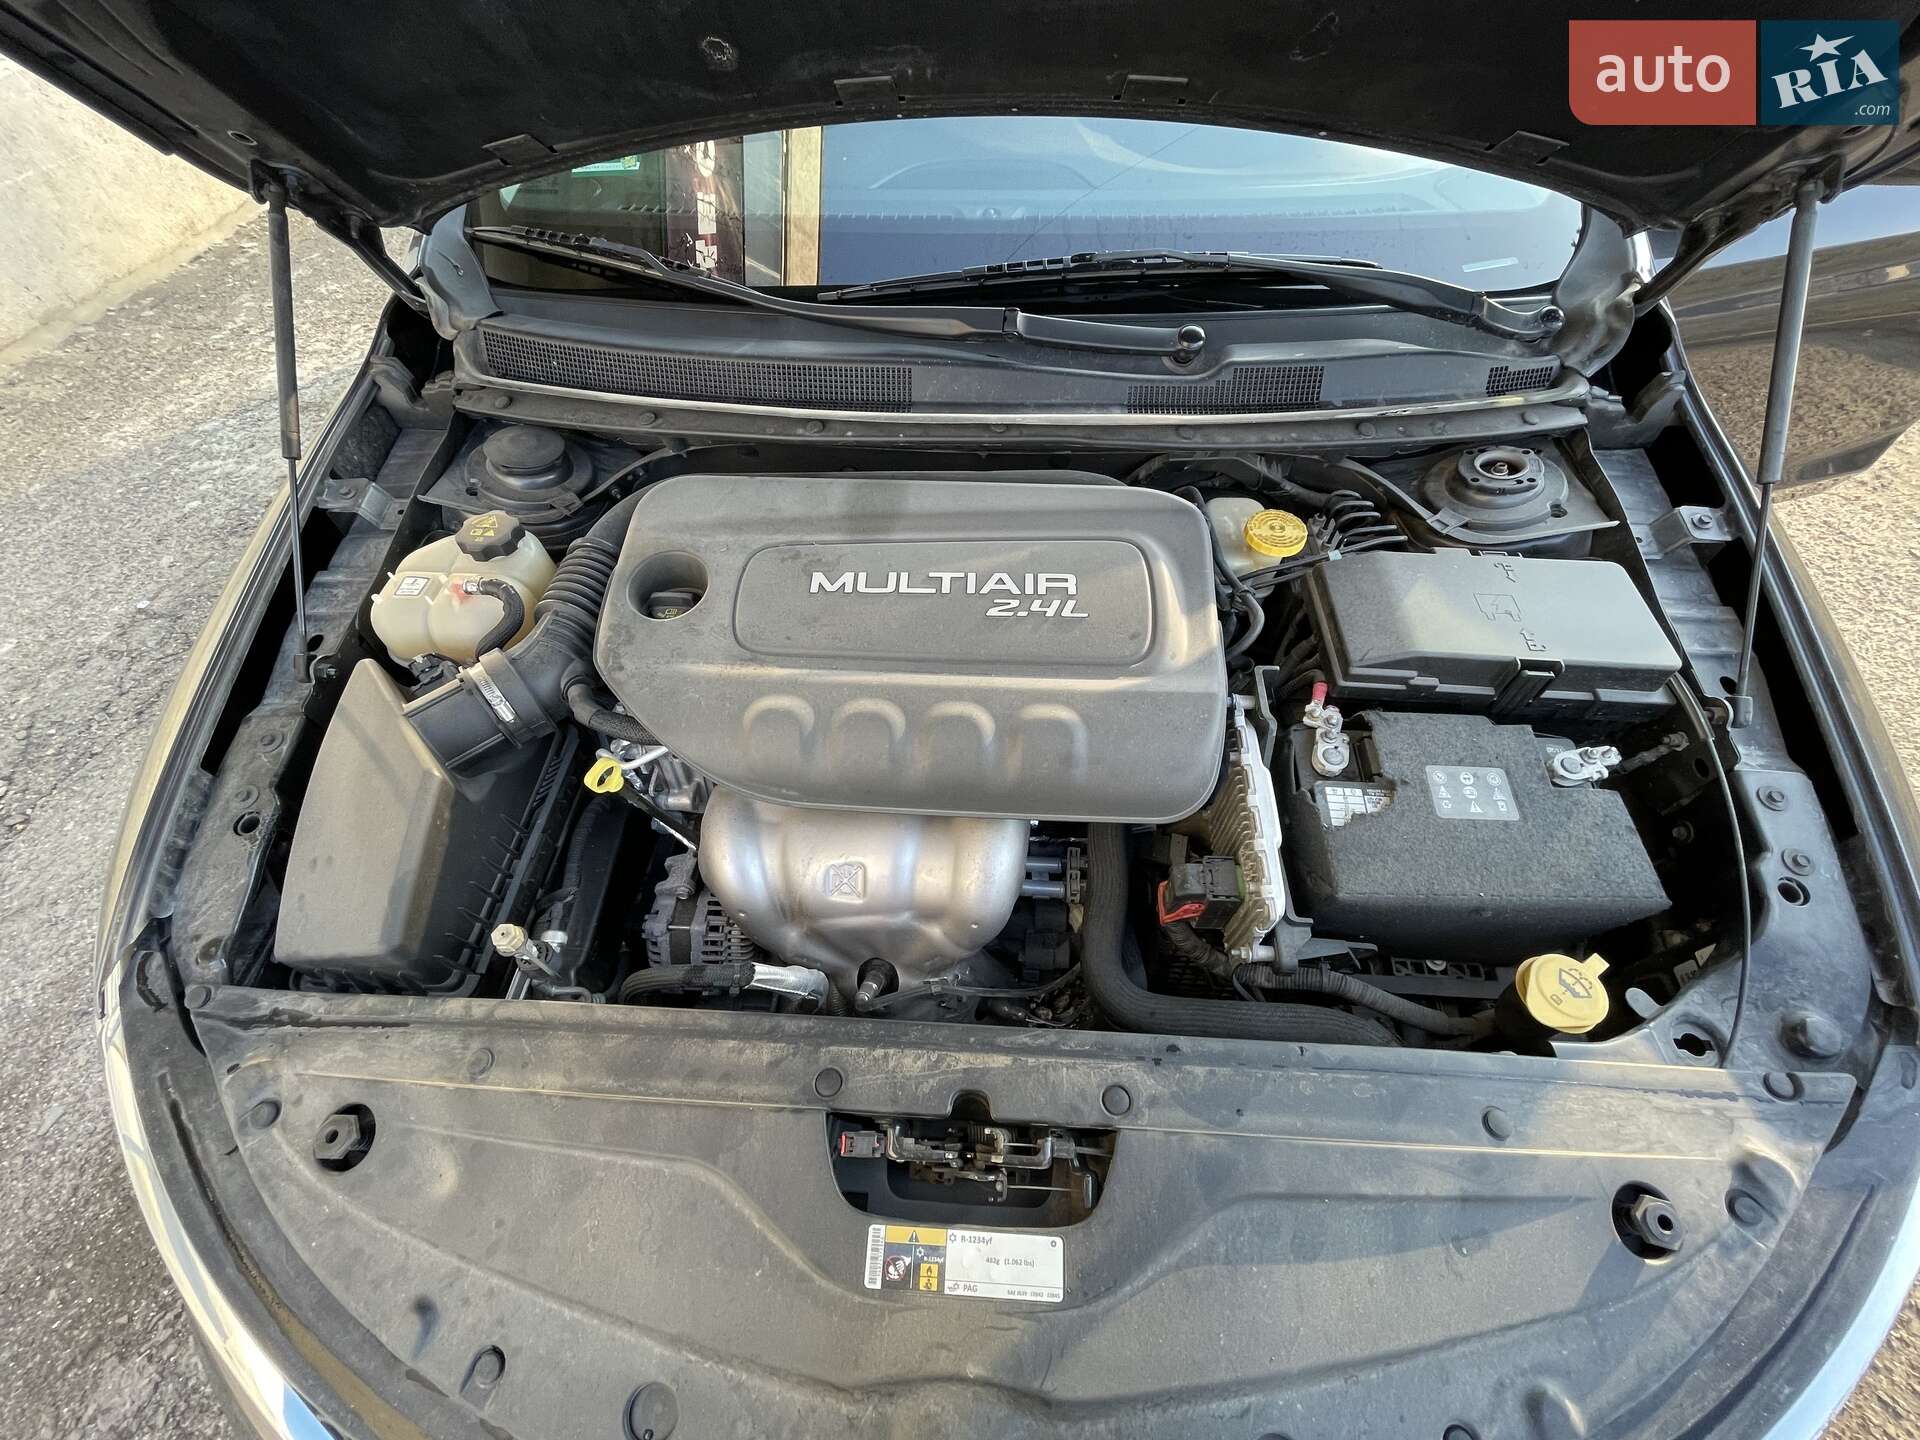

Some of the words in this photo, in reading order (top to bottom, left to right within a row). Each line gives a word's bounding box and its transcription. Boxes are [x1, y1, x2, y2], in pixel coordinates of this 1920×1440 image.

[810, 571, 1078, 595] MULTIAIR
[985, 599, 1089, 617] 2.4L
[960, 1236, 993, 1246] R-1234yf
[963, 1285, 978, 1293] PAG
